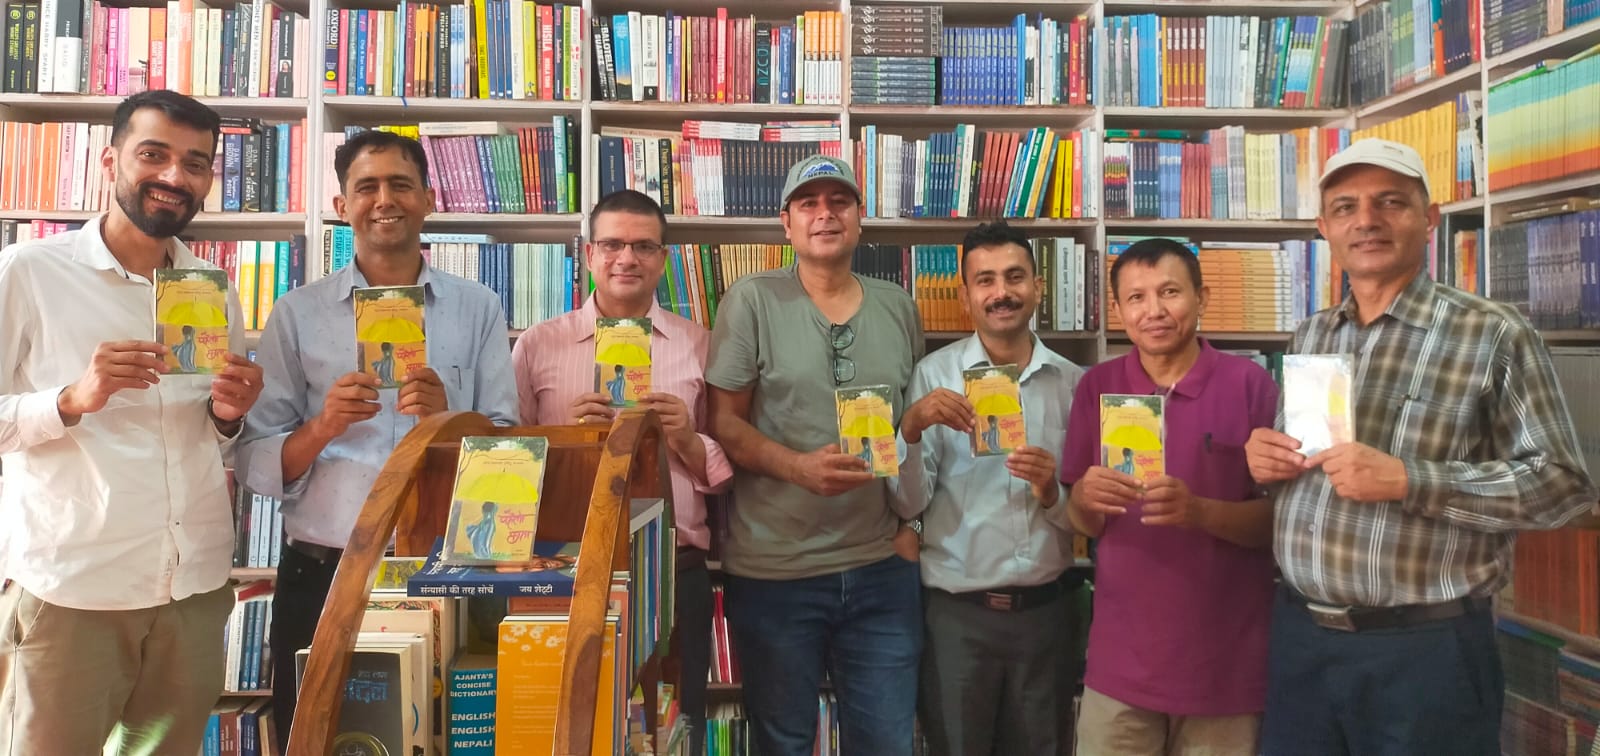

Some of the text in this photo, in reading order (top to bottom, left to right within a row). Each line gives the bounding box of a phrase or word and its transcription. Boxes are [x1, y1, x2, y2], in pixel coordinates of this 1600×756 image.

[542, 24, 552, 52] HISILA
[595, 34, 604, 66] SUAREZ
[601, 28, 614, 72] BALOTELLI
[226, 142, 235, 168] BROWN
[245, 144, 253, 168] BROWN
[808, 170, 834, 178] NEPAL
[449, 584, 460, 594] की
[462, 586, 476, 594] तरह
[520, 585, 532, 594] जय
[452, 712, 496, 720] ENGLISH
[452, 726, 495, 734] ENGLISH
[454, 740, 492, 748] NEPALI
